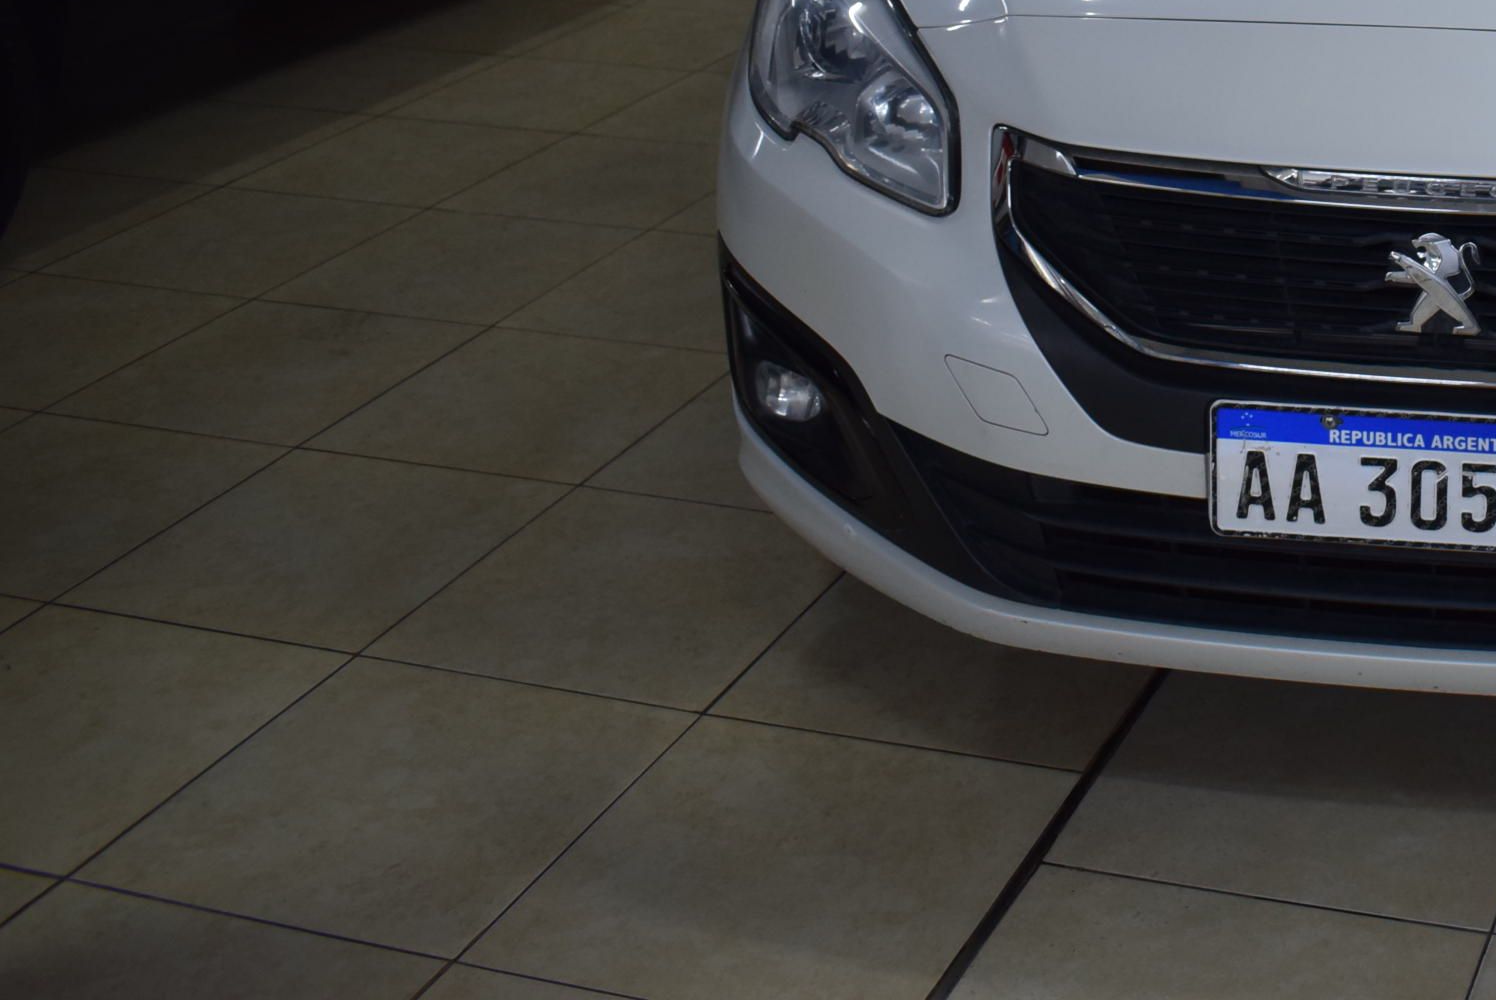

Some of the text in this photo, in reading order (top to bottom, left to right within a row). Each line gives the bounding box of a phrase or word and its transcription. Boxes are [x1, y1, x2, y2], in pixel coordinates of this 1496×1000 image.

[1230, 430, 1267, 439] MERCOSUR
[1328, 429, 1425, 449] REPUBLICA
[1236, 450, 1326, 524] AA
